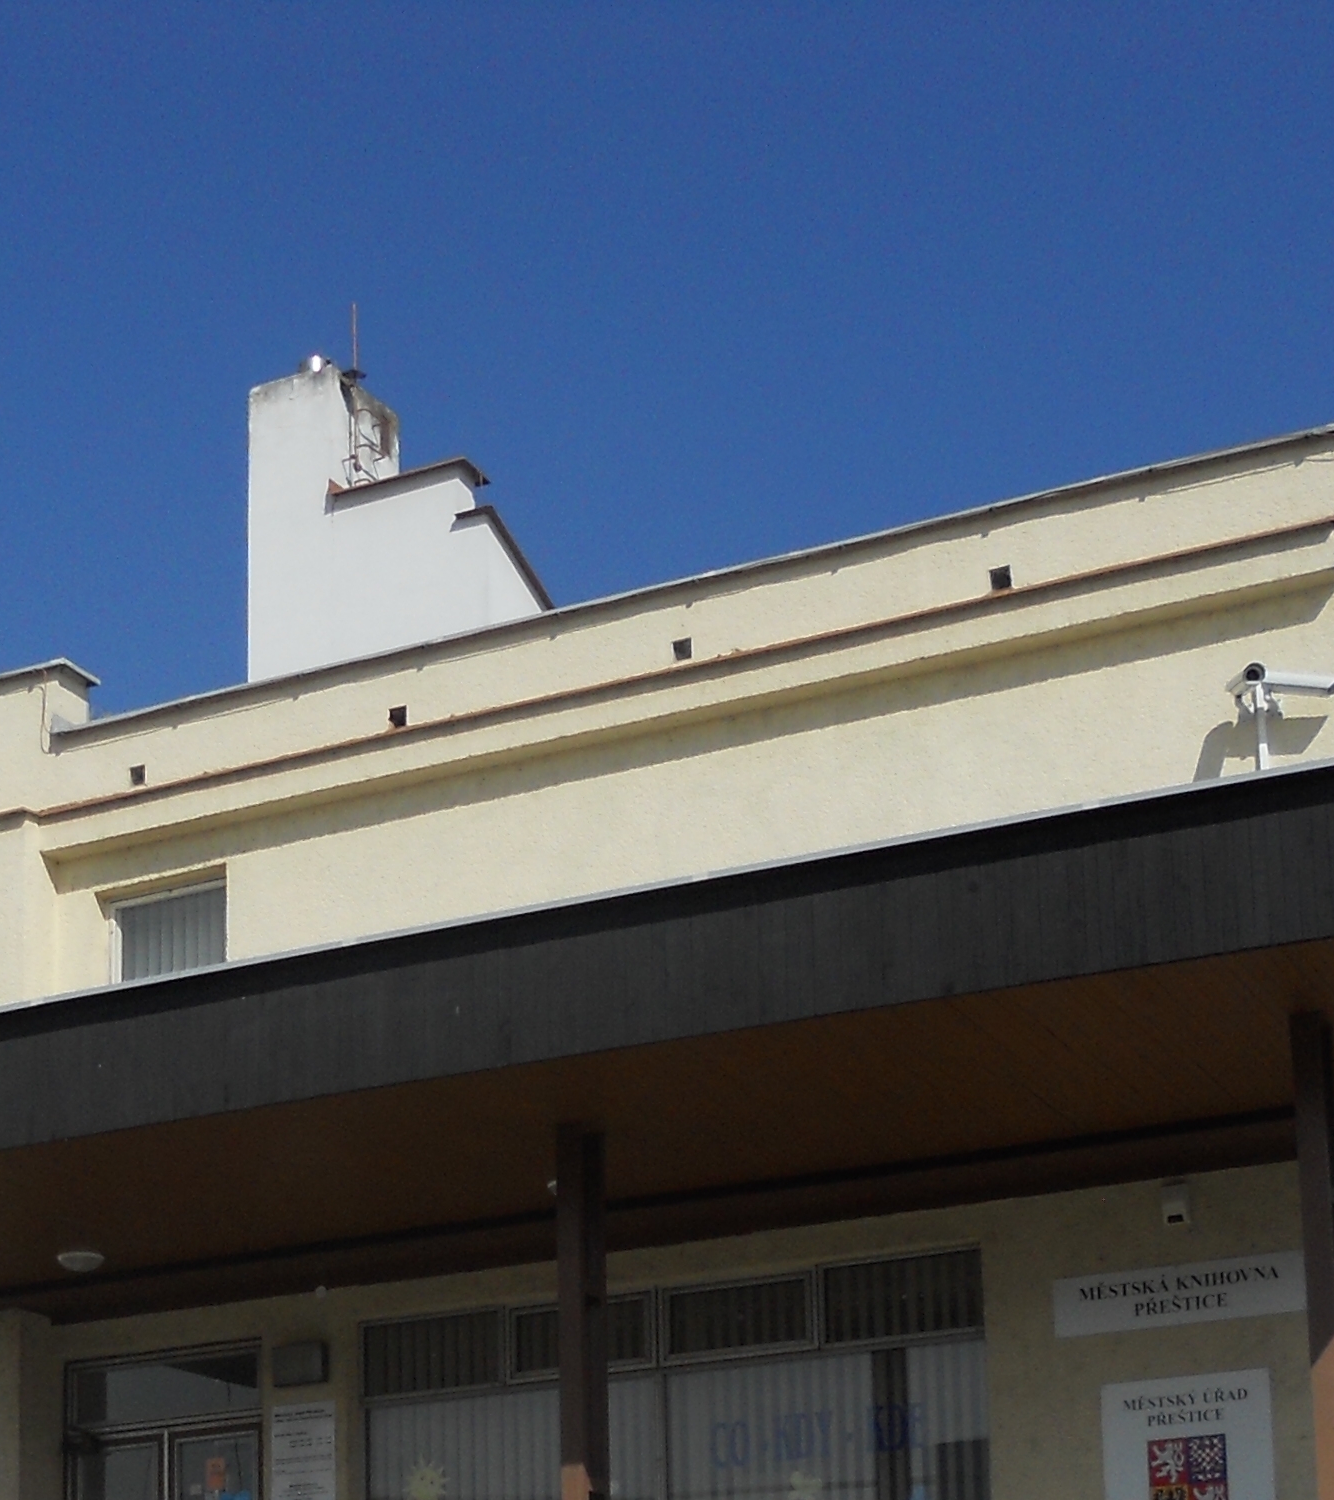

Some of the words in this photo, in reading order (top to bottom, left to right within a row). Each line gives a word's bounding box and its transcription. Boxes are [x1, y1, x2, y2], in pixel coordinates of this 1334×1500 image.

[1080, 1274, 1169, 1301] MĚSTSKÁ
[1176, 1266, 1279, 1291] KNIHOVNA
[1134, 1292, 1227, 1317] PŘEŠTICE
[1123, 1392, 1197, 1411] MĚSTSKÝ
[1203, 1388, 1248, 1404] ÚŘAD
[1147, 1407, 1226, 1427] PŘEŠTICE
[710, 1420, 751, 1468] CO
[774, 1408, 832, 1461] KDY
[867, 1402, 926, 1452] KDE
